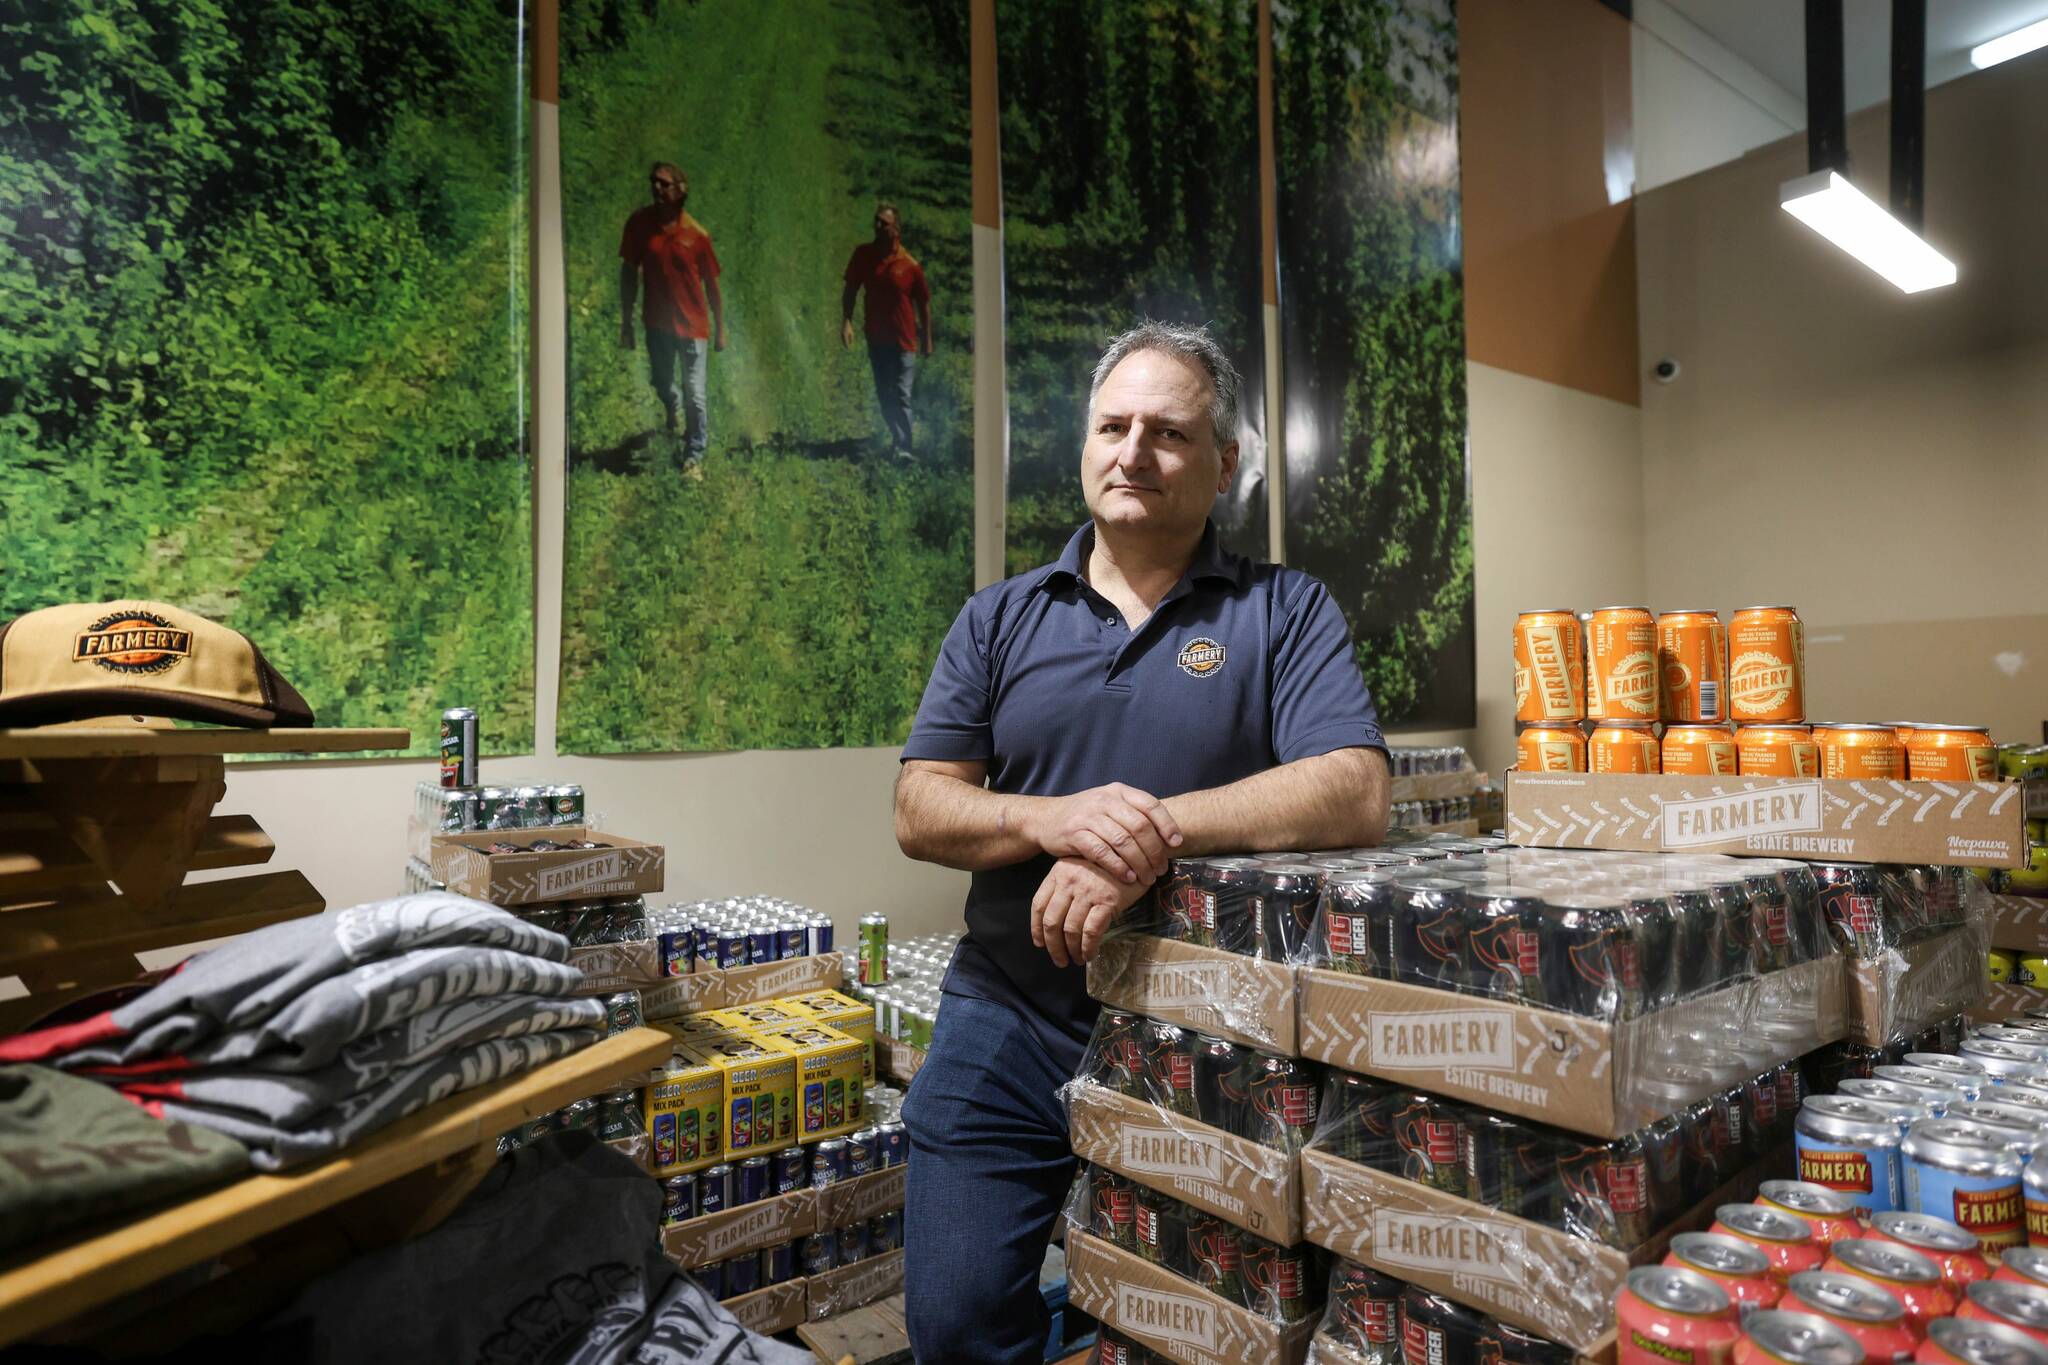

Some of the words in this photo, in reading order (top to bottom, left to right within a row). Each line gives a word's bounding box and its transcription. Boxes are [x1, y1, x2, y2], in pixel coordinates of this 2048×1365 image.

[86, 631, 181, 655] FARMERY
[1181, 649, 1222, 665] FARMERY
[1532, 634, 1570, 709] FARMERY
[1678, 792, 1806, 837] FARMERY
[1746, 834, 1790, 851] ESTATE
[1792, 836, 1855, 854] BREWERY
[1947, 836, 2010, 851] Neepawa,
[1948, 848, 2009, 859] MANITOBA
[546, 857, 614, 890] FARMERY
[607, 879, 636, 892] BREWERY
[1205, 895, 1215, 929] LAGER
[1353, 917, 1366, 956] LAGER
[762, 964, 807, 992] FARMERY
[1382, 1018, 1500, 1058] FARMERY
[731, 1069, 757, 1084] BEER
[803, 1055, 828, 1070] BEER
[804, 1071, 815, 1081] MIX
[816, 1068, 832, 1079] PACK
[731, 1085, 744, 1095] MIX
[745, 1083, 761, 1094] PACK
[1445, 1065, 1488, 1093] ESTATE
[1489, 1074, 1549, 1108] BREWERY
[653, 1101, 667, 1111] MIX
[668, 1099, 685, 1110] PACK
[1730, 1104, 1741, 1145] LAGER
[1130, 1134, 1213, 1175] FARMERY
[1800, 1158, 1867, 1182] FARMERY
[667, 1203, 690, 1217] CAESAR
[1174, 1175, 1203, 1200] ESTATE
[1203, 1183, 1245, 1216] BREWERY
[714, 1210, 773, 1250] FARMERY
[1149, 1210, 1158, 1247] LAGER
[1453, 1271, 1495, 1301] ESTATE
[1126, 1293, 1207, 1337] FARMERY
[1168, 1338, 1196, 1363] ESTATE
[1428, 1331, 1442, 1365] AGER
